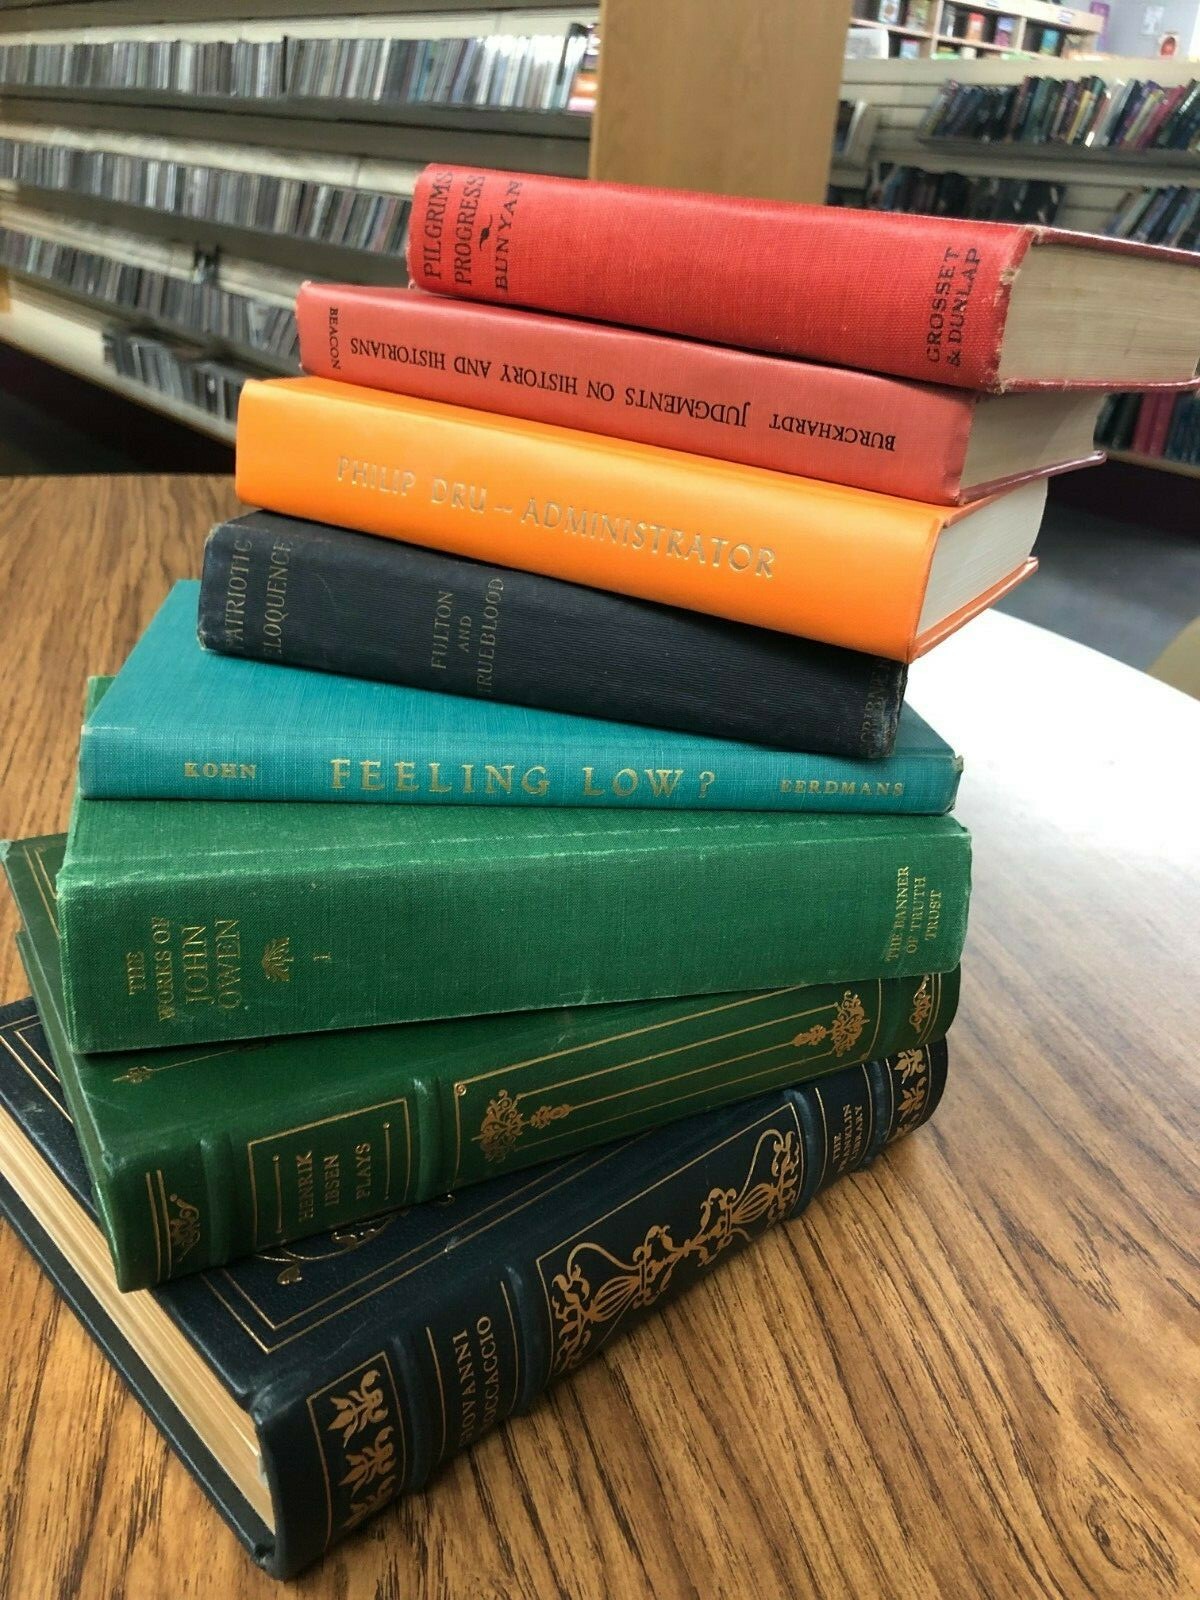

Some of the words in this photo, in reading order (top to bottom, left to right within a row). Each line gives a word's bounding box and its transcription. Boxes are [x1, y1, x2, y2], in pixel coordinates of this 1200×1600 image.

[424, 172, 453, 280] PILGRIMS
[454, 175, 486, 286] PROGRESS
[496, 180, 523, 292] BUNYAN
[926, 247, 960, 363] GROSSET
[948, 248, 981, 344] DUNLAP
[329, 306, 341, 370] BEACON
[350, 337, 446, 371] HISTORIANS
[947, 349, 961, 367] &
[453, 355, 492, 379] AND
[500, 363, 578, 396] HISTORY
[586, 379, 615, 402] ON
[625, 387, 751, 427] JUDGMENTS
[768, 413, 897, 452] BURCKHARDT
[336, 455, 417, 497] PHILIP
[430, 477, 488, 515] DRU
[520, 497, 777, 580] ADMINISTRATOR
[263, 536, 294, 656] LOQUENCE
[431, 590, 455, 670] FULTON
[458, 615, 473, 654] AND
[183, 761, 257, 781] KOHN
[330, 757, 551, 796] FEELING
[779, 779, 906, 797] EERDMANS
[894, 866, 909, 929] BANNER
[910, 876, 927, 932] TRUTH
[925, 889, 942, 941] TRUST
[151, 916, 171, 944] OF
[126, 951, 147, 996] THE
[156, 950, 176, 1022] WORKS
[181, 925, 216, 1006] JOHN
[214, 917, 242, 1010] OWEN
[355, 1142, 372, 1201] PLAYS
[476, 1315, 501, 1434] OCCACCIO
